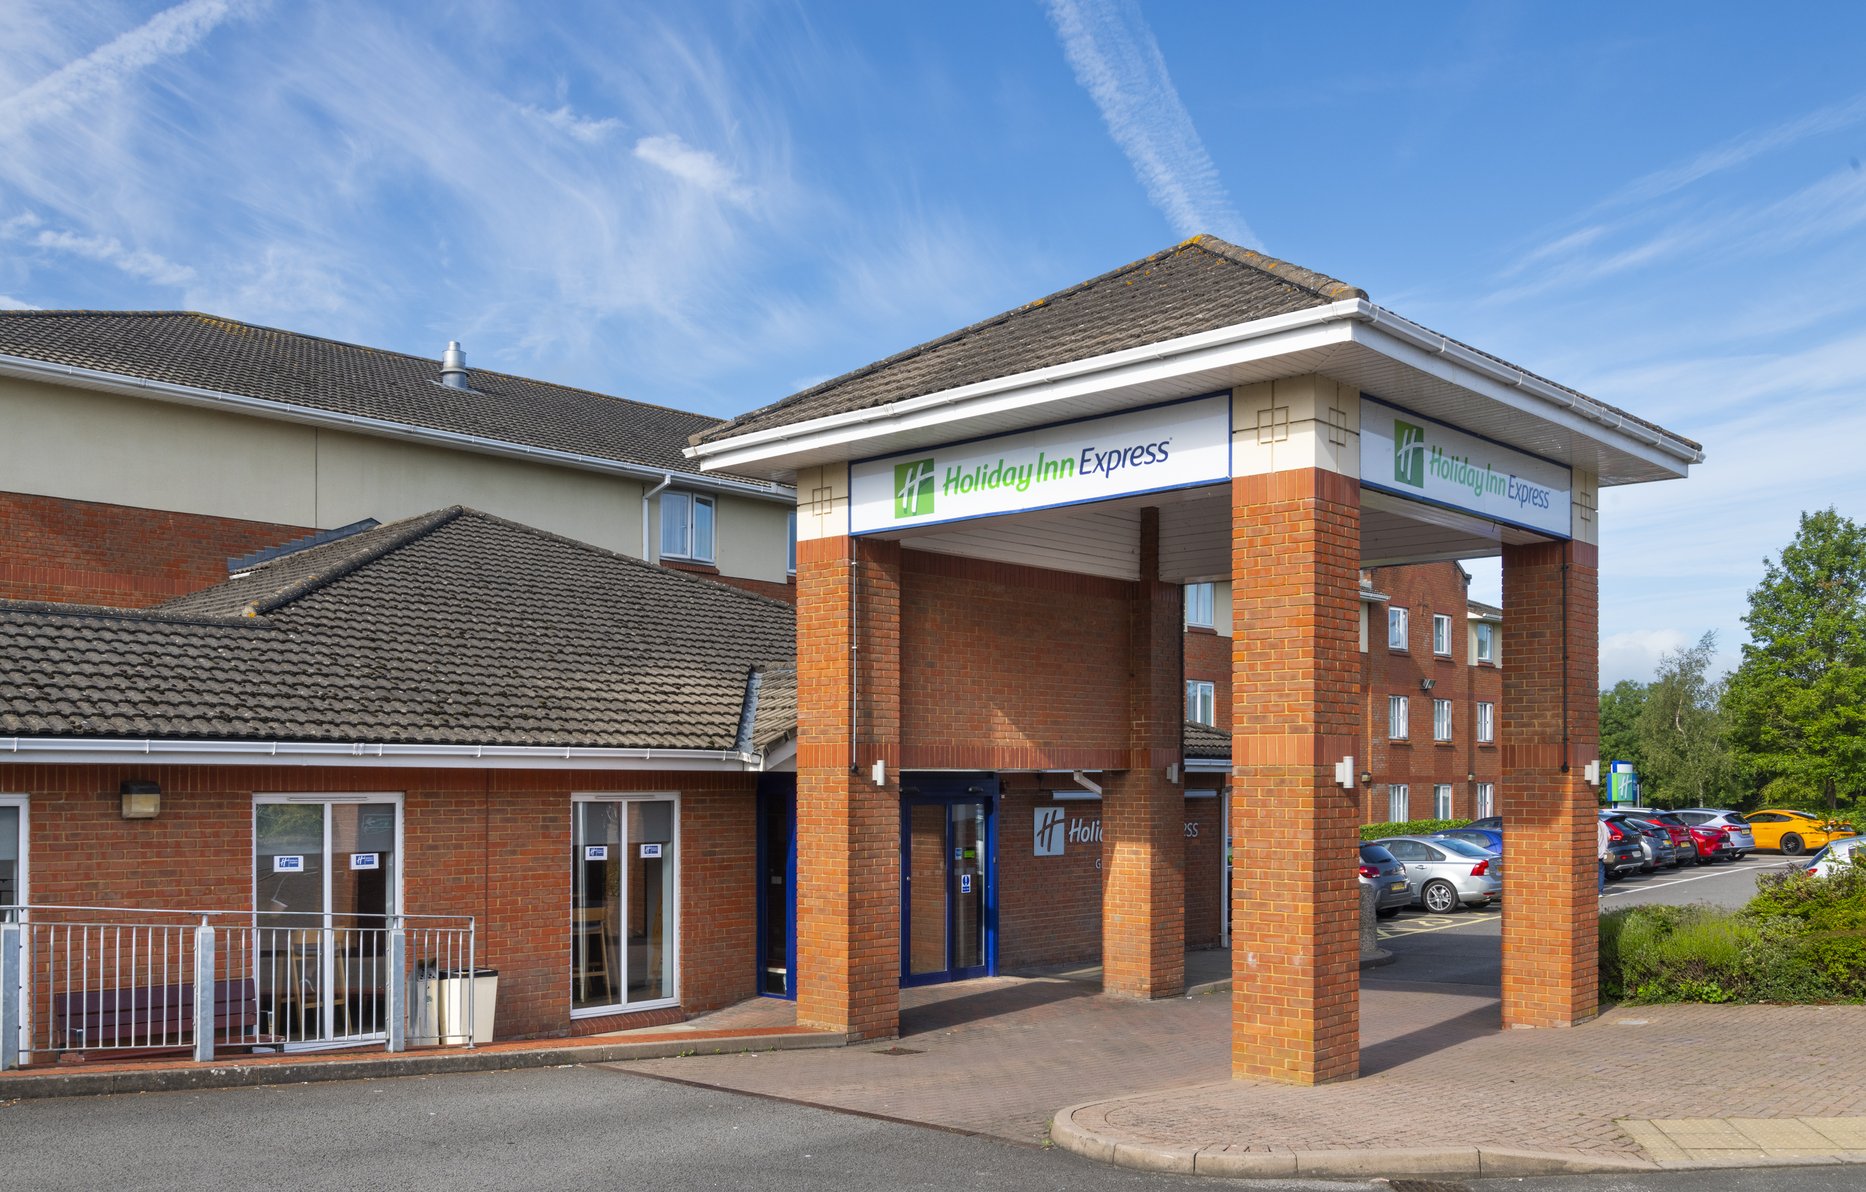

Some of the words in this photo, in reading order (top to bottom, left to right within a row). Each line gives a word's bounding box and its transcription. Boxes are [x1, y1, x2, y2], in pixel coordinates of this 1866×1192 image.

[943, 459, 1034, 497] Holiday
[1036, 452, 1075, 482] Inn
[1079, 440, 1170, 479] Express
[1429, 445, 1484, 497] Holiday
[1486, 463, 1506, 497] Inn
[1508, 474, 1550, 509] Express
